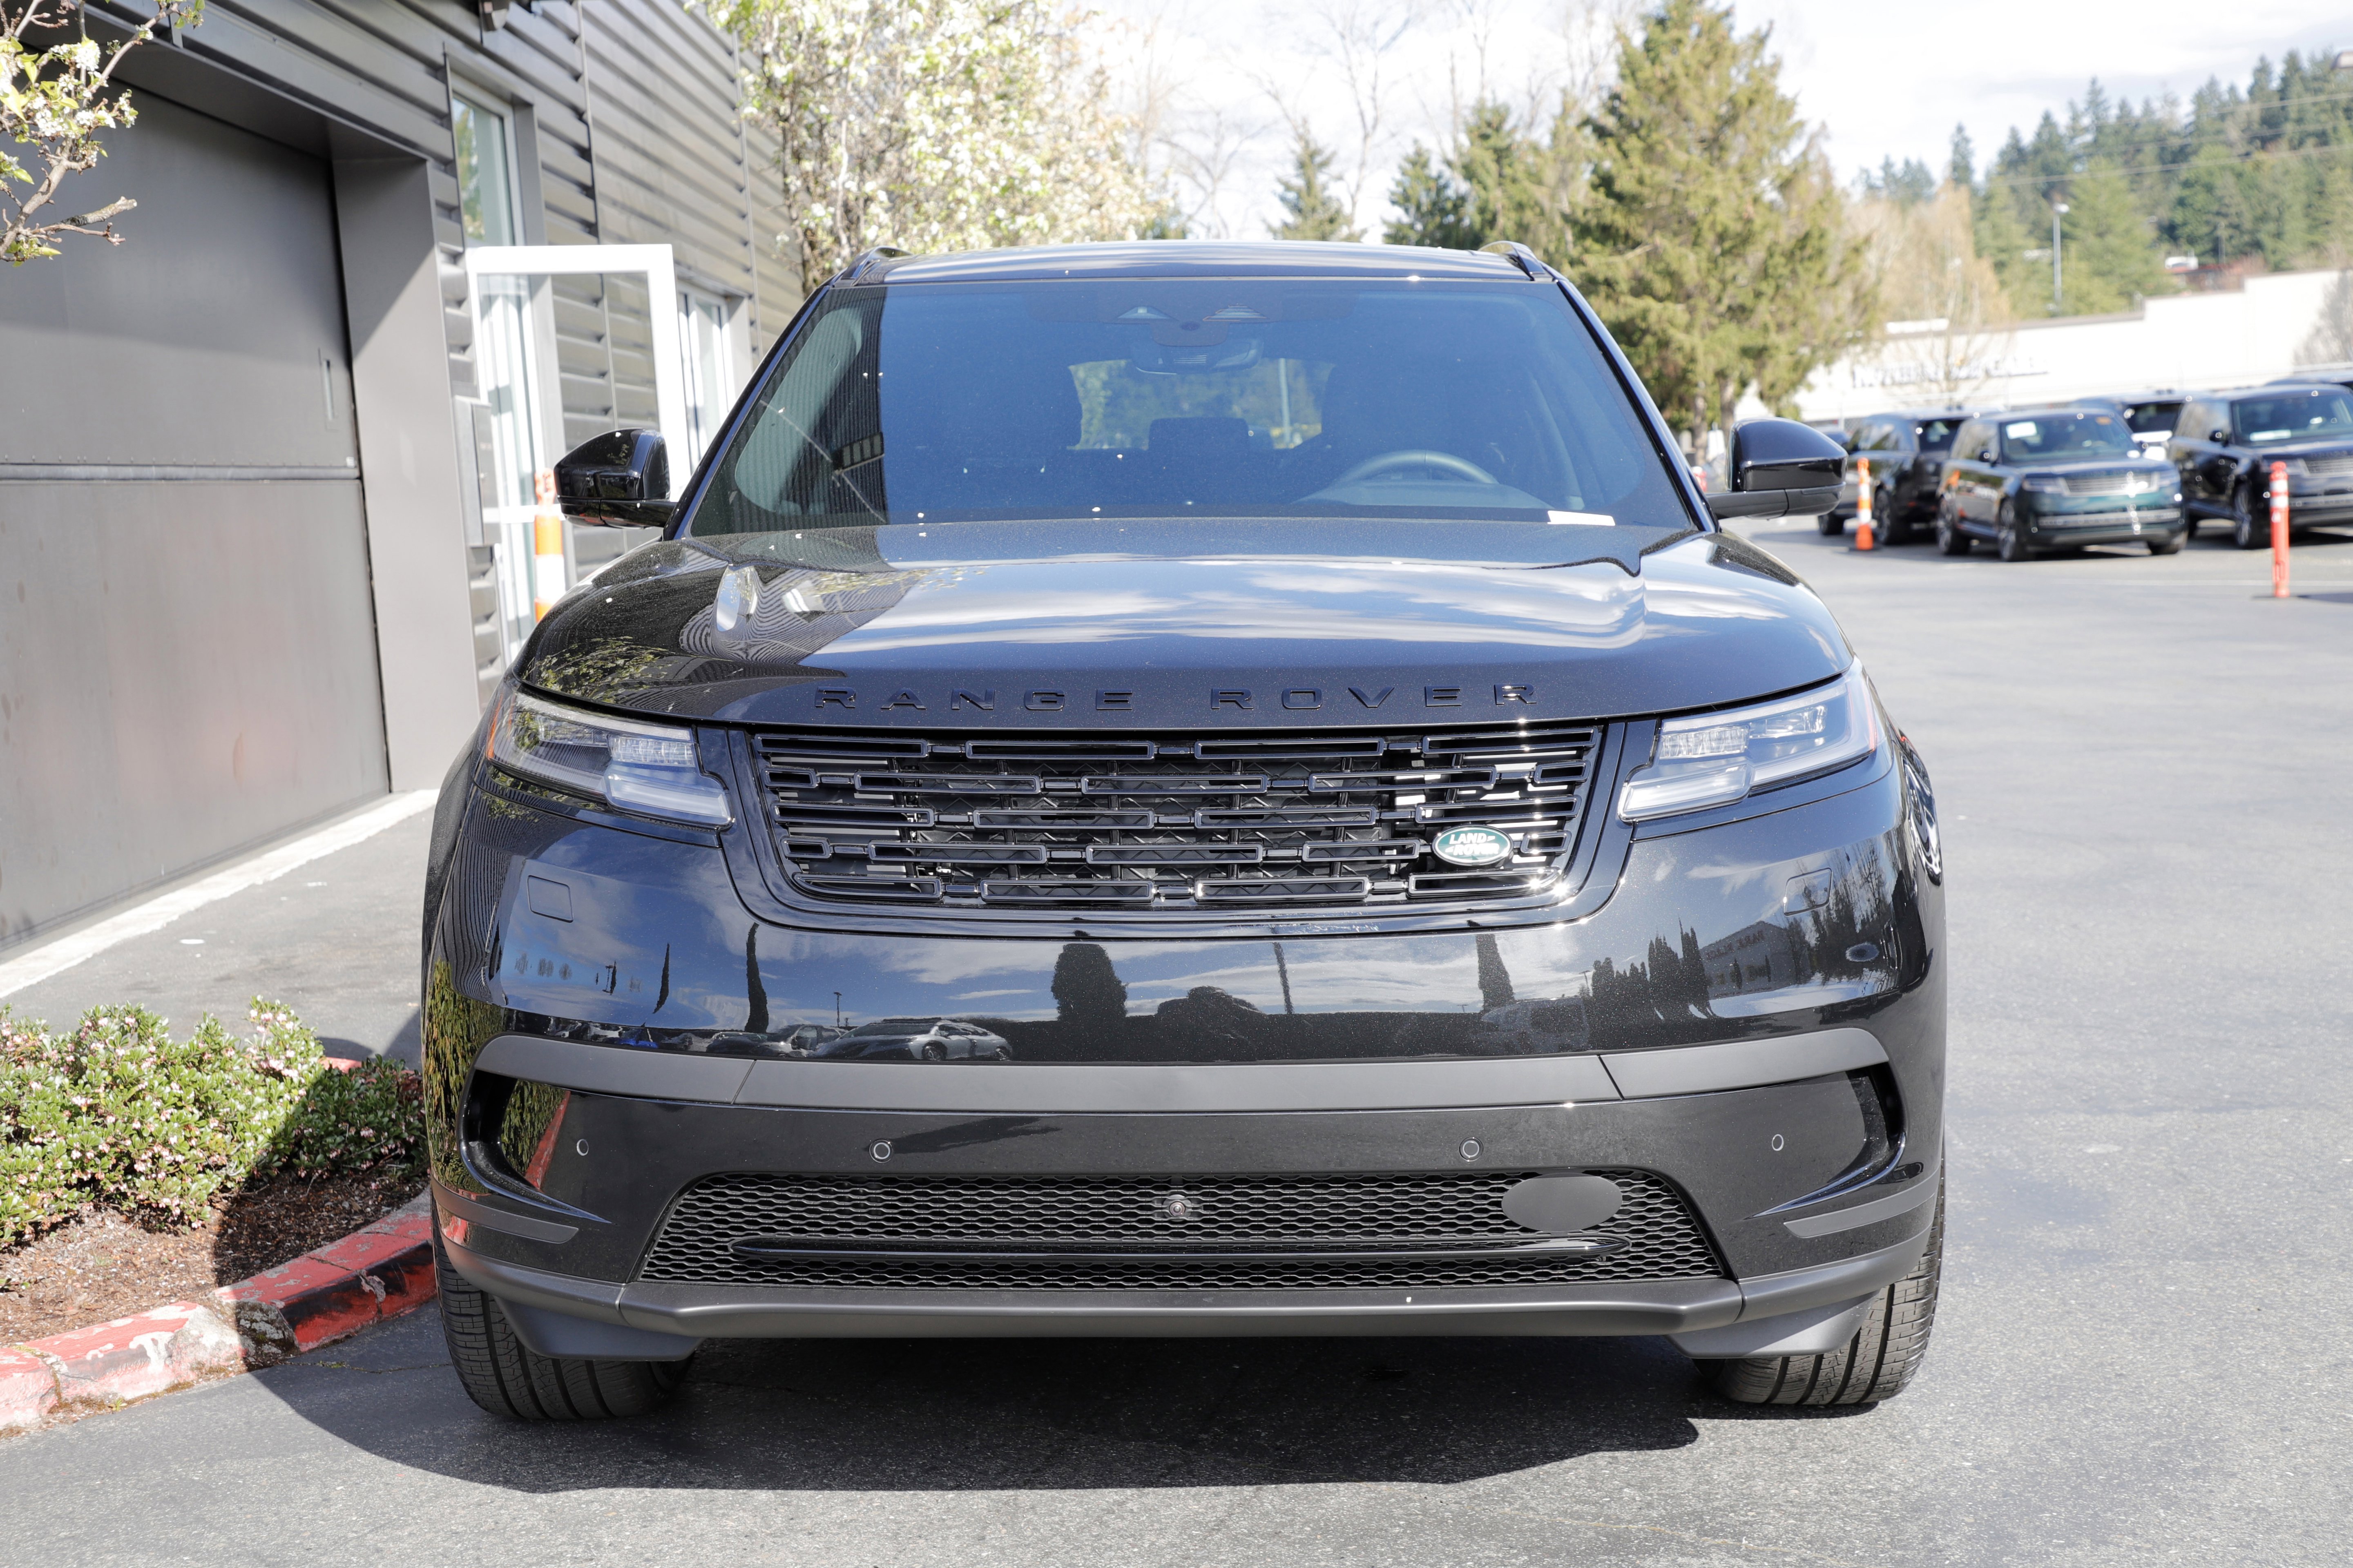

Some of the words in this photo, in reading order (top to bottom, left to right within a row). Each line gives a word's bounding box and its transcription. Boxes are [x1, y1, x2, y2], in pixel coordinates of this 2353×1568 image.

[814, 686, 1133, 711] RANGE
[1210, 683, 1538, 710] ROVER
[1449, 833, 1487, 844] LAND
[1453, 843, 1500, 856] ROVER
